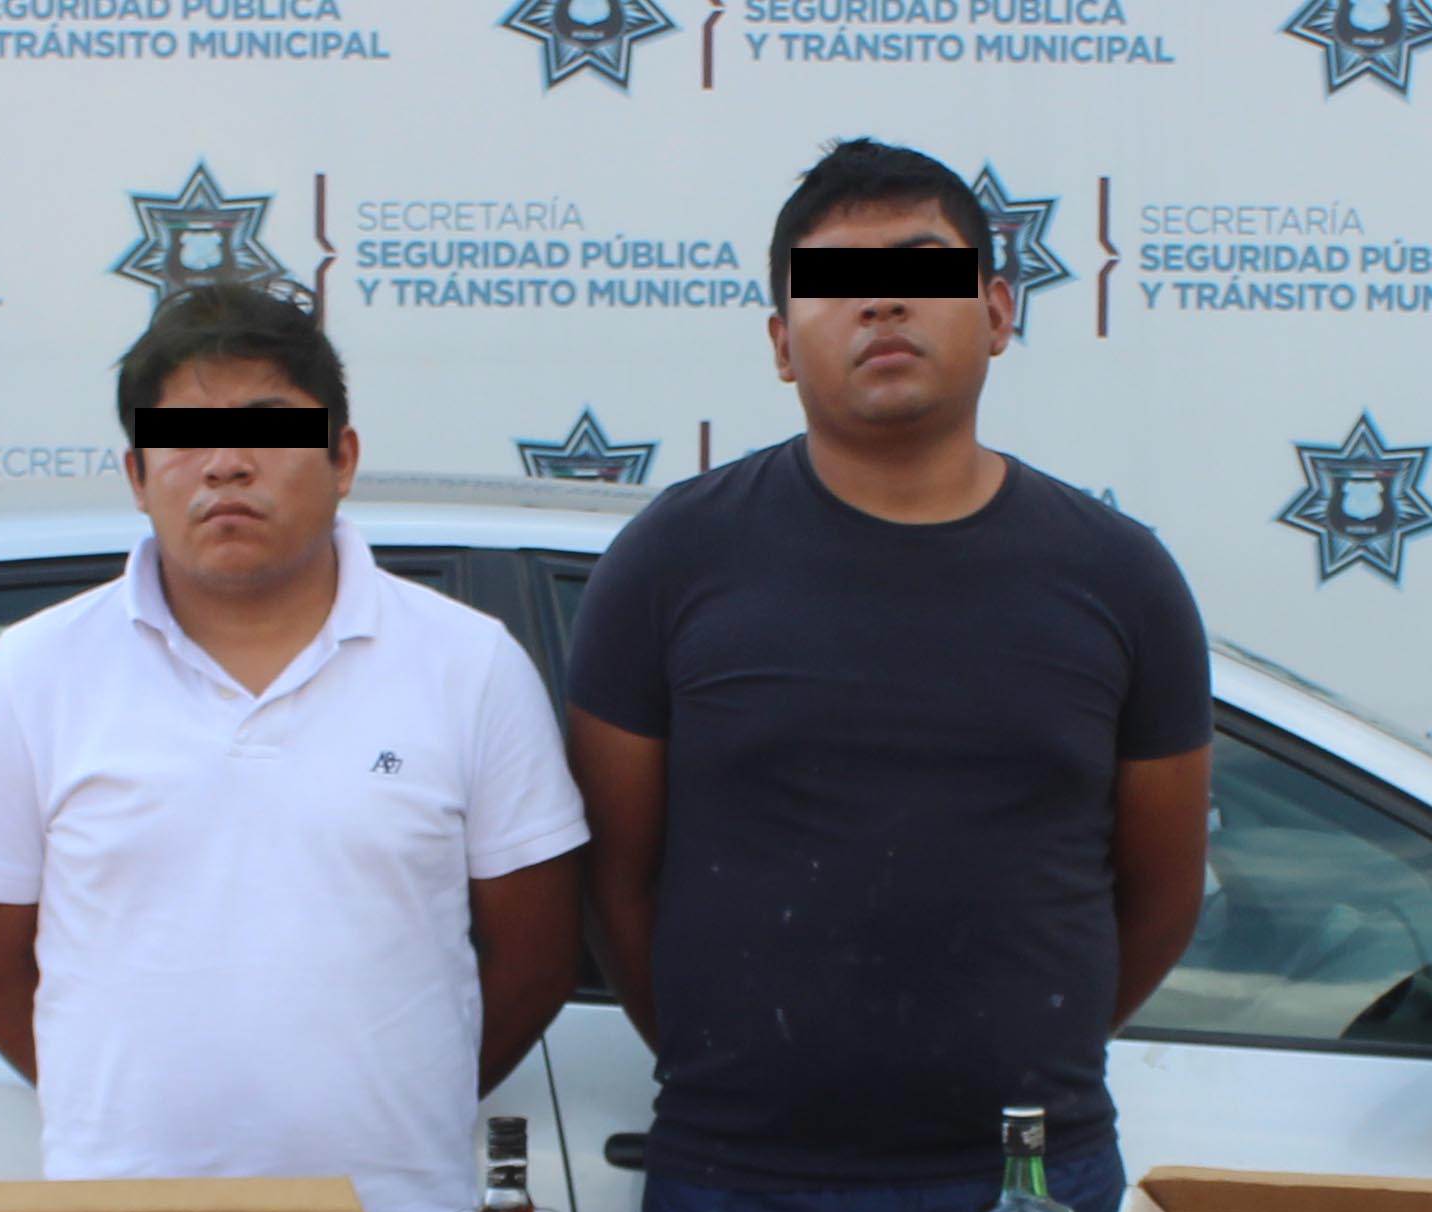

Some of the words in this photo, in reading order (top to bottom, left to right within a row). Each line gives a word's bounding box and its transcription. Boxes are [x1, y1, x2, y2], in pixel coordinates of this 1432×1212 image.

[745, 0, 960, 22] SEGURIDAD
[188, 30, 391, 58] MUNICIPAL
[745, 32, 770, 60] Y
[778, 24, 966, 60] TRÁNSITO
[976, 34, 1176, 62] MUNICIPAL
[358, 196, 583, 230] SECRETARÍA
[1142, 200, 1364, 234] SECRETARÍA
[357, 240, 571, 268] SEGURIDAD
[581, 232, 739, 268] PÚBLICA
[1140, 243, 1351, 271] SEGURIDAD
[355, 277, 382, 305] Y
[390, 270, 577, 306] TRÁNSITO
[588, 279, 772, 306] MUNICIPA
[1139, 281, 1165, 309] Y
[1172, 273, 1357, 309] TRÁNSITO
